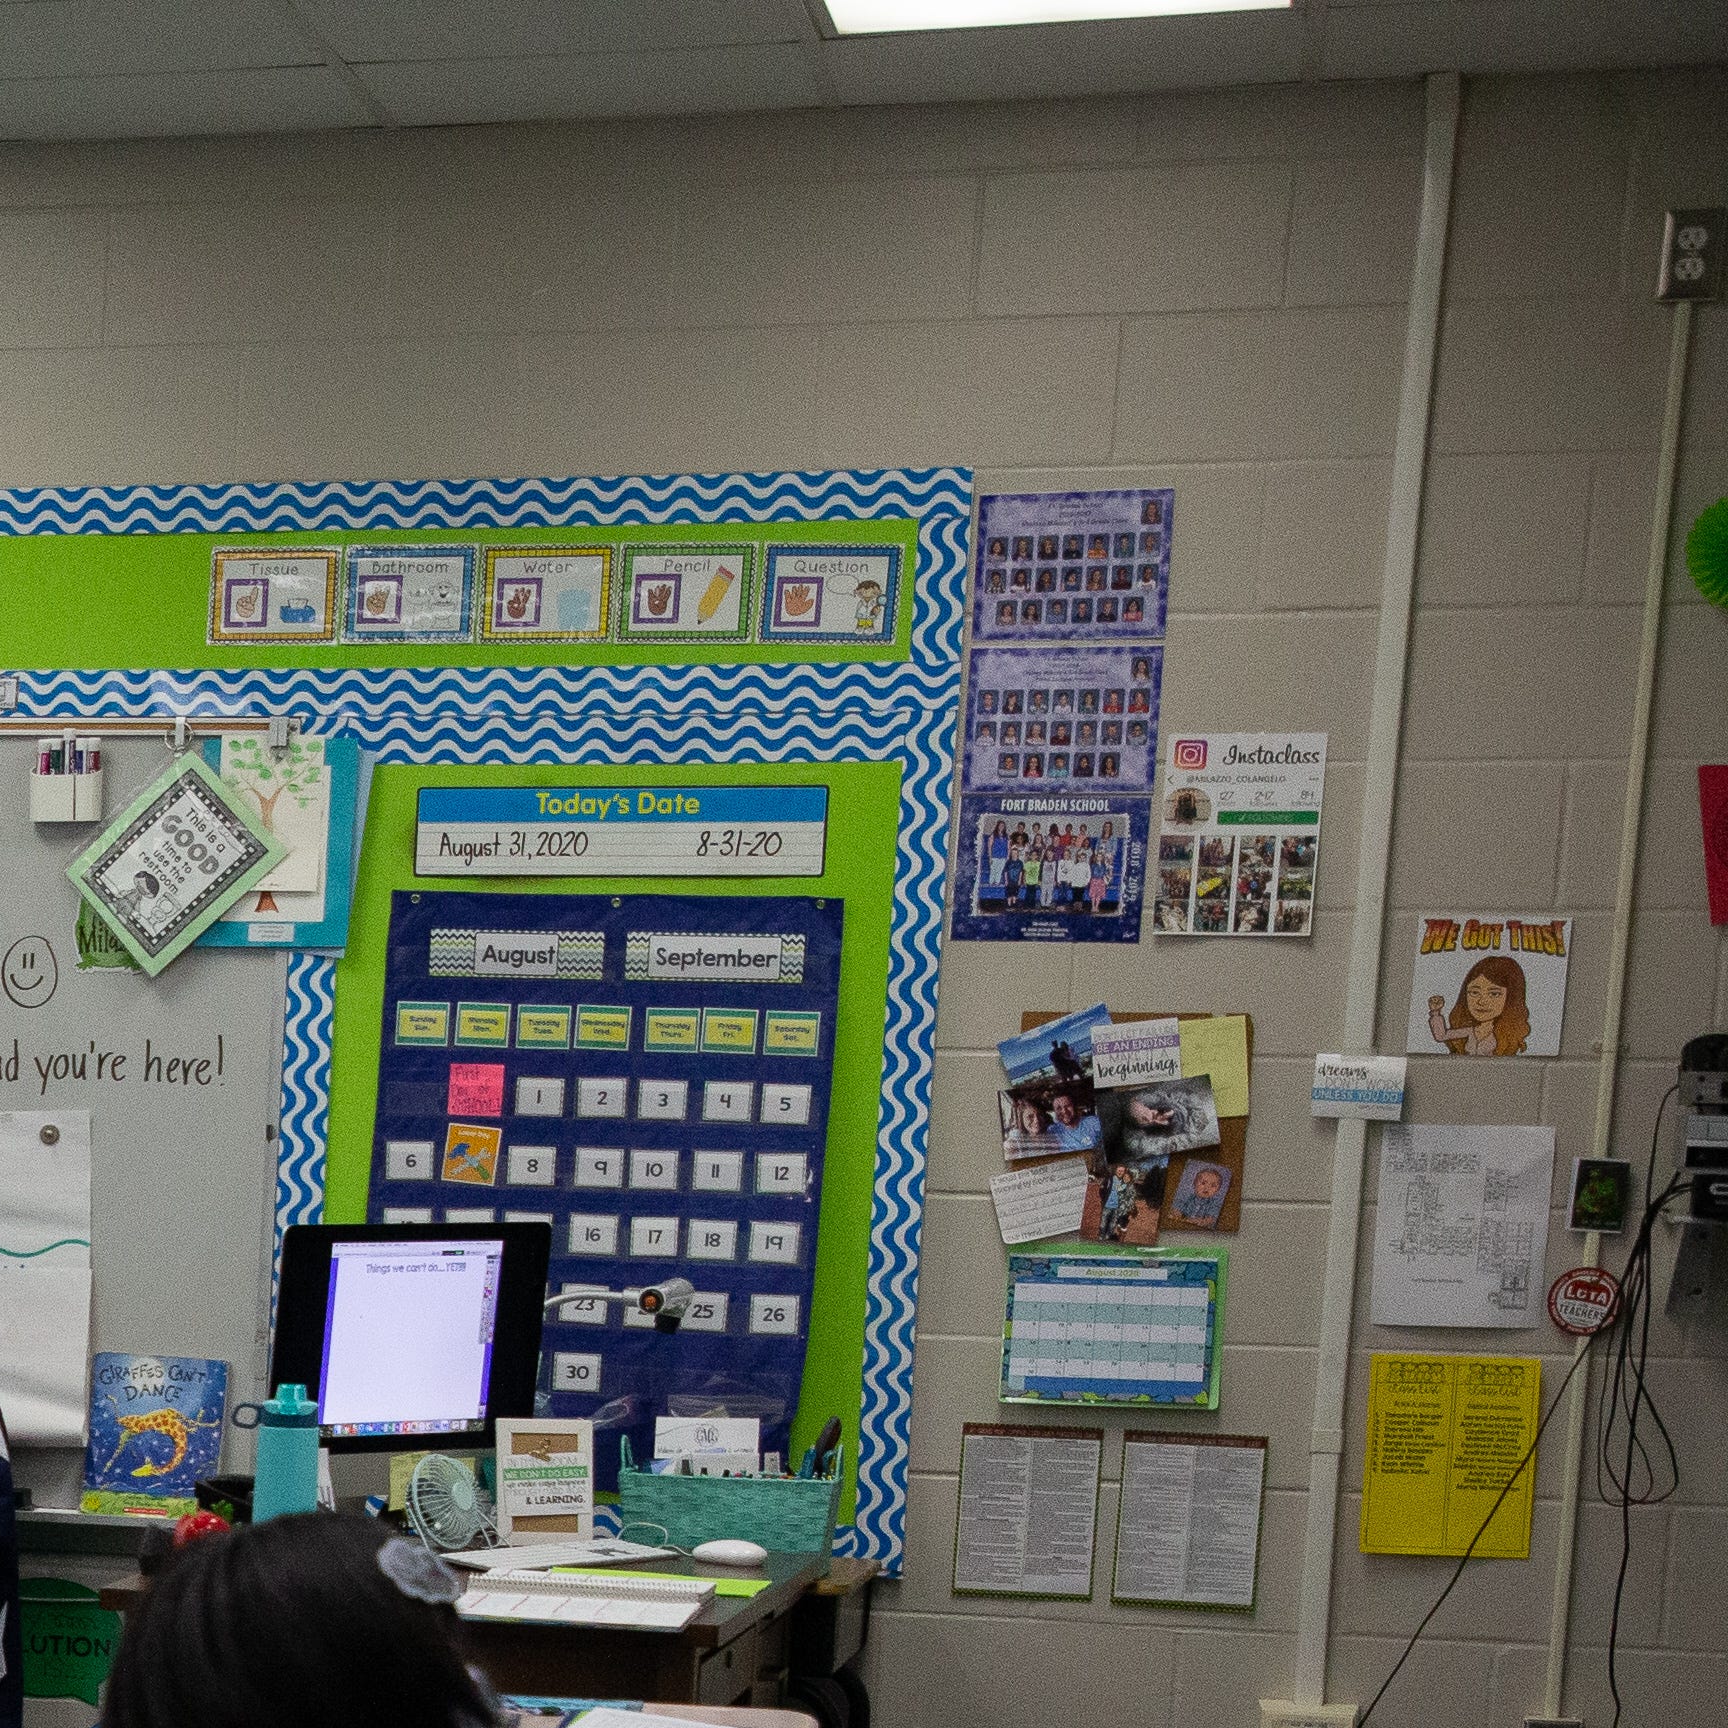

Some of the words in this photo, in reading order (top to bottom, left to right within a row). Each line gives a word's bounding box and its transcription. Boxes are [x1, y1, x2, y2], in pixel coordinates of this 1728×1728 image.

[249, 561, 300, 578] Tissue
[371, 558, 450, 577] Bathroom
[523, 558, 573, 575] Water
[663, 557, 711, 574] Pencil
[793, 558, 870, 577] Question
[1222, 743, 1321, 766] Instaclass
[536, 791, 630, 820] Today's
[637, 792, 701, 816] Date
[1000, 798, 1026, 812] FORT
[1028, 798, 1067, 812] BRADEN
[1070, 799, 1110, 812] SCHOOL
[185, 807, 207, 832] This
[205, 829, 219, 844] is
[216, 843, 226, 854] a
[161, 814, 220, 876] GOOD
[439, 831, 502, 867] August
[536, 831, 589, 858] 2020
[696, 829, 783, 858] 8-31-20
[153, 850, 169, 868] use
[170, 865, 186, 885] the
[162, 840, 182, 864] time
[182, 861, 192, 875] to
[139, 851, 179, 895] restroom
[481, 945, 557, 970] August
[655, 947, 779, 972] September
[34, 1040, 128, 1096] you're
[144, 1035, 225, 1088] here!
[1096, 1058, 1180, 1081] beginning.
[597, 1091, 608, 1106] 2
[658, 1093, 669, 1107] 3
[720, 1094, 732, 1109] 4
[780, 1097, 791, 1112] 5
[405, 1154, 417, 1168] 6
[527, 1158, 538, 1173] 8
[595, 1161, 607, 1176] 9
[646, 1162, 664, 1178] 10
[774, 1166, 789, 1181] 12
[585, 1227, 601, 1242] 16
[648, 1229, 663, 1244] 17
[705, 1233, 721, 1248] 18
[766, 1236, 783, 1251] 19
[366, 1263, 391, 1275] Things
[392, 1264, 405, 1273] we
[692, 1304, 714, 1319] 25
[763, 1307, 785, 1322] 26
[98, 1363, 164, 1385] GIRAFFES
[566, 1365, 589, 1380] 30
[123, 1384, 183, 1403] DANCE
